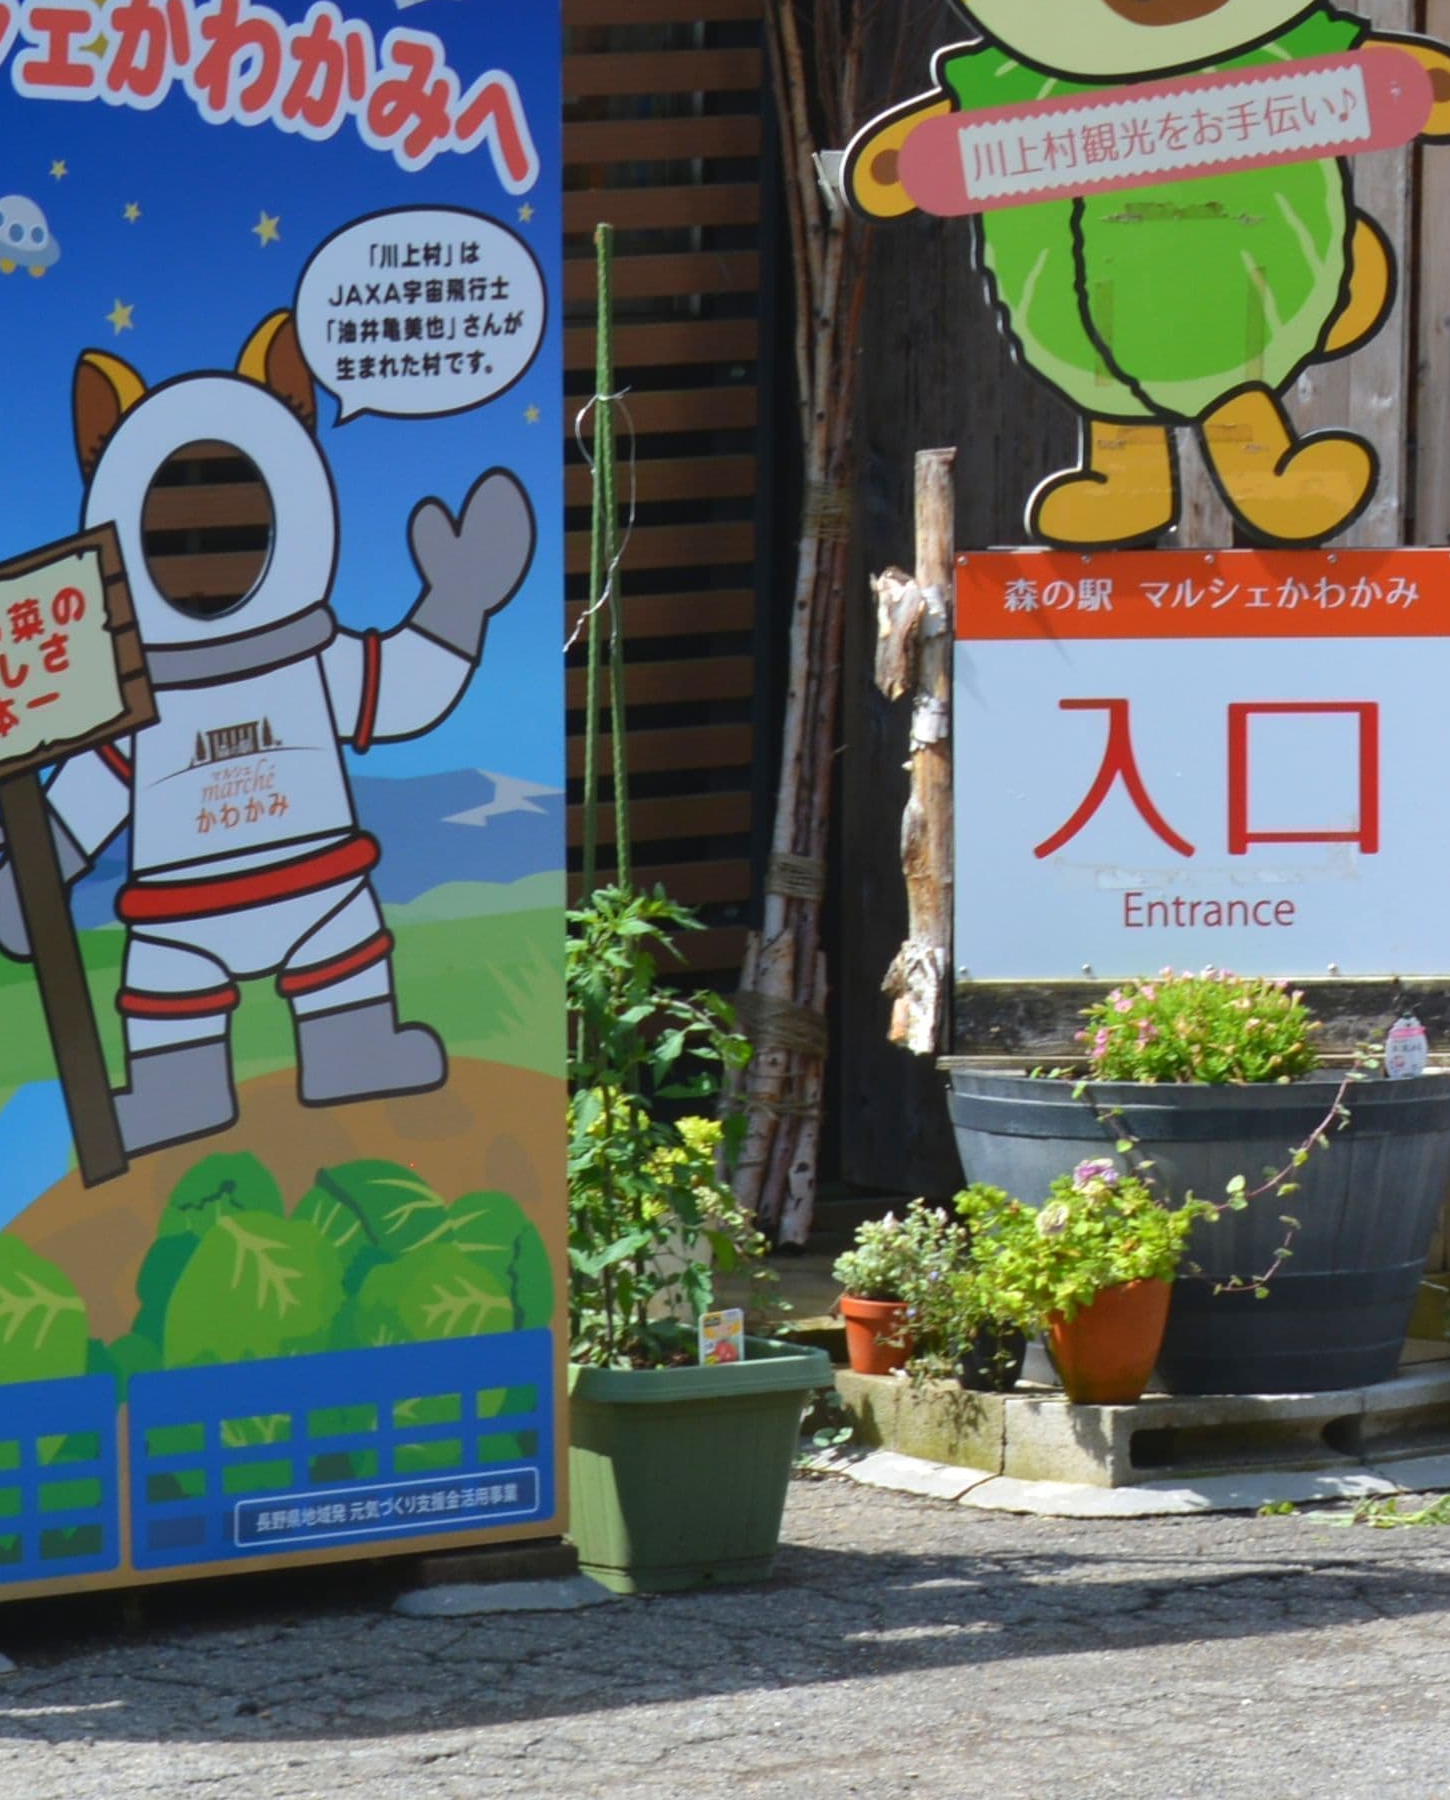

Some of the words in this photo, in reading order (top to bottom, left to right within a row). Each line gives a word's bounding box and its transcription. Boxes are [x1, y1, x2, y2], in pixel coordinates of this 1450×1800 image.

[369, 241, 481, 269] 「川上村」は
[328, 275, 511, 307] JAXA宇宙飛行士
[336, 349, 494, 381] 生まれた村です。
[1003, 577, 1114, 612] 森の駅
[1138, 575, 1420, 610] マルシェかわかみ
[1033, 697, 1380, 859] 入口
[195, 791, 291, 834] かわかみ
[1123, 891, 1297, 929] Entrance
